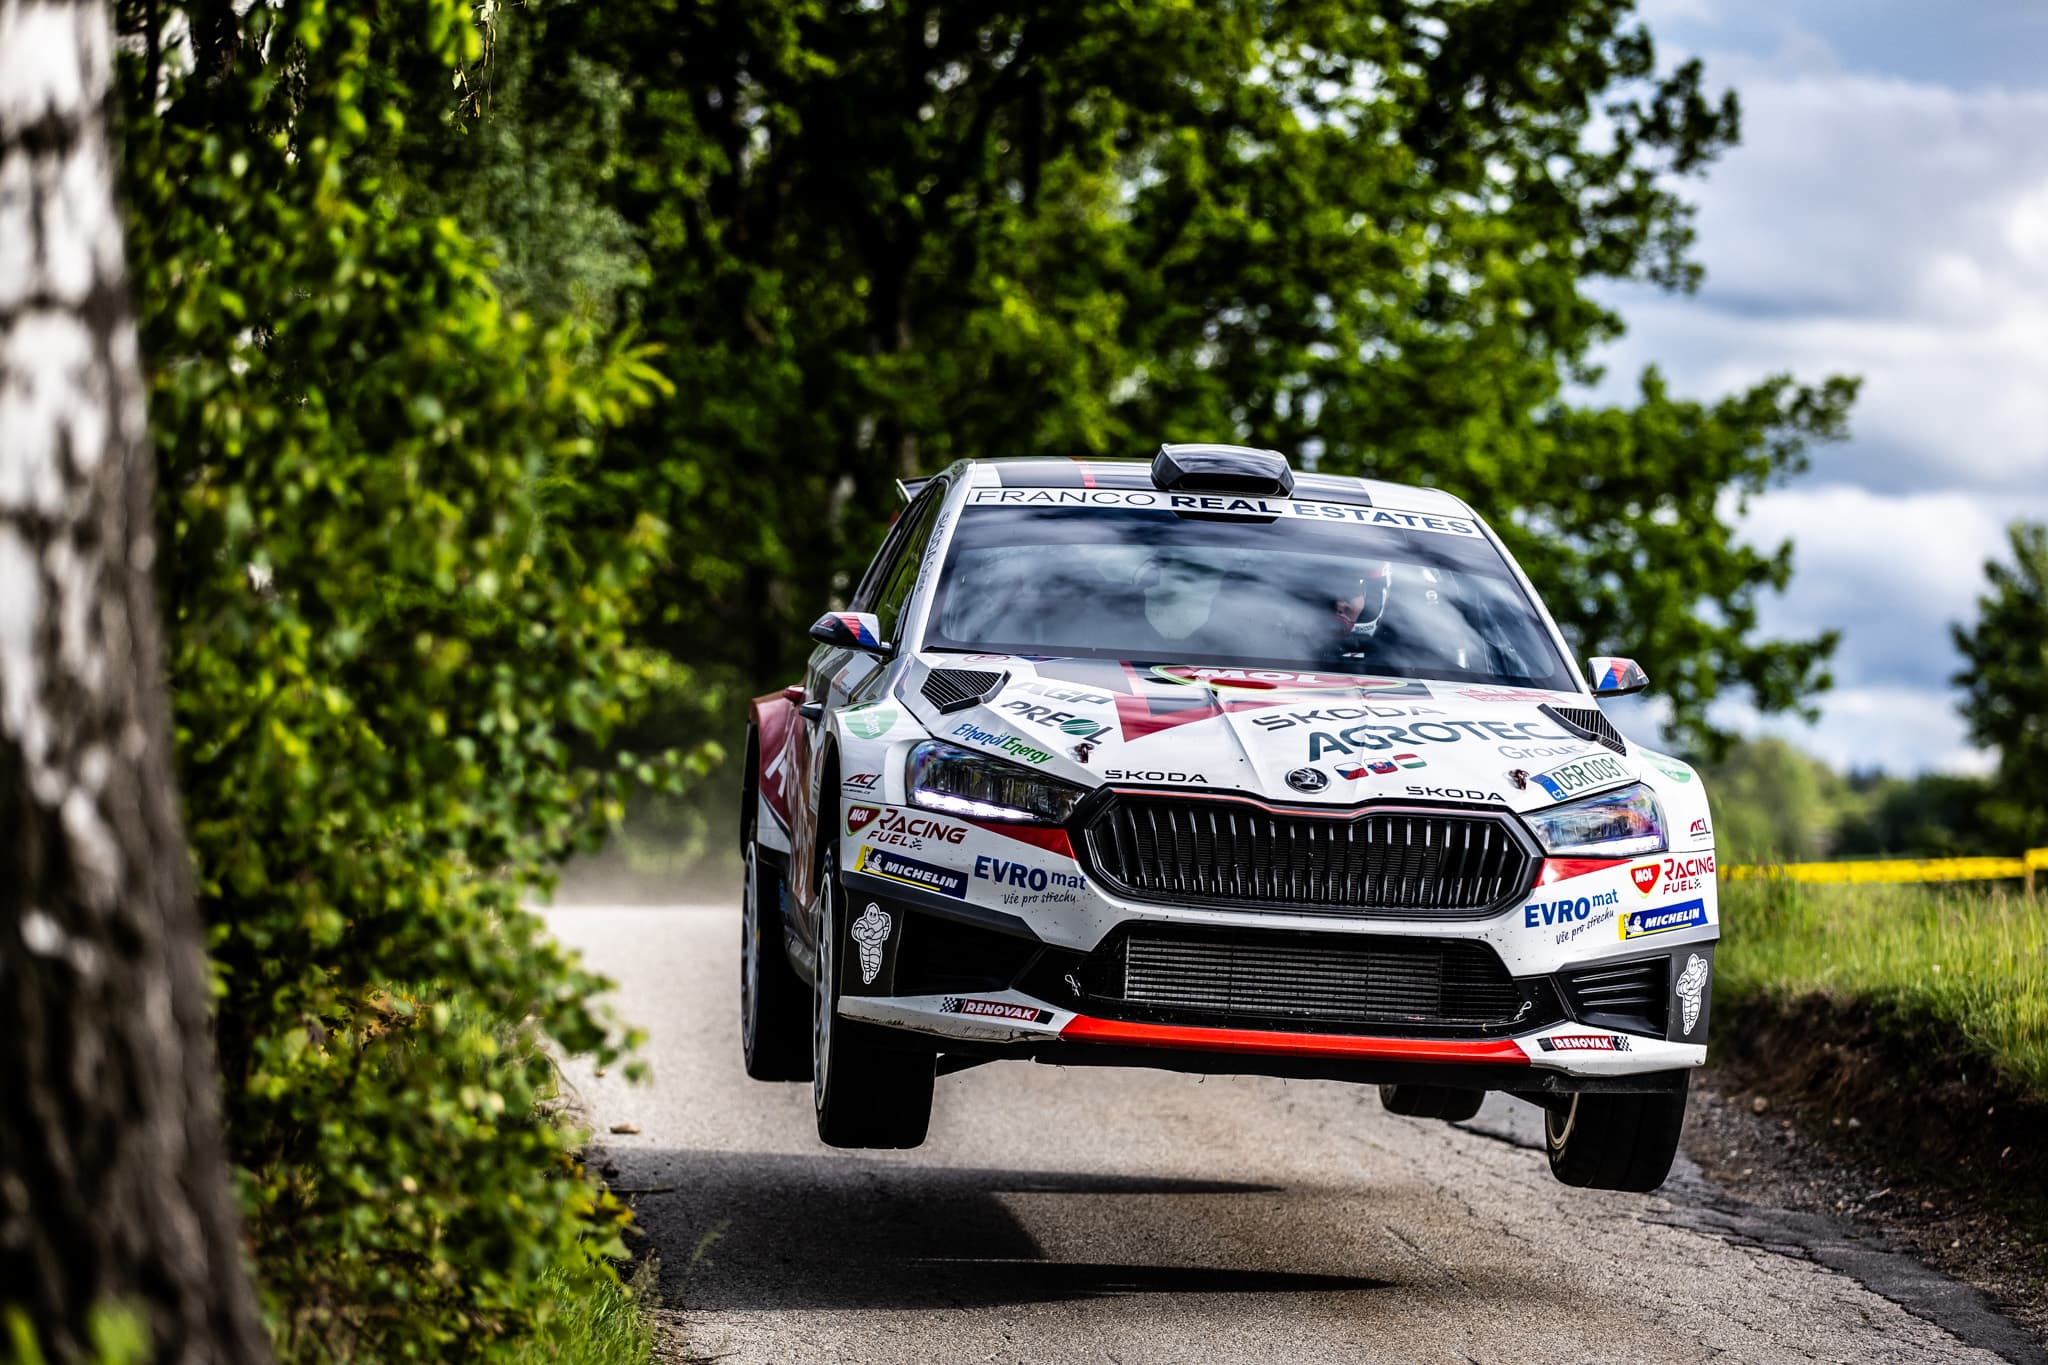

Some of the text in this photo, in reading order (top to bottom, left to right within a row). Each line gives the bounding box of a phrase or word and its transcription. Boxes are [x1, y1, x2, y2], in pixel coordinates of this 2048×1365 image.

[975, 490, 1474, 535] FRANCO REAL ESTATES
[1192, 668, 1324, 684] MOL
[1309, 719, 1576, 762] AGROTEC
[846, 773, 883, 790] ACL
[878, 808, 969, 845] RACING
[1690, 817, 1711, 834] ACL
[866, 830, 911, 847] FUEL
[884, 861, 959, 889] MICHELIN
[973, 855, 1087, 892] EVRO mat
[1634, 868, 1654, 884] MOL
[1663, 856, 1715, 881] RACING
[1662, 880, 1694, 895] FUEL
[1003, 893, 1019, 905] Vše
[1021, 894, 1039, 908] pro
[1524, 888, 1619, 929] EVRO mat
[1644, 908, 1700, 929] MICHELIN
[1555, 931, 1570, 945] Vše
[1571, 924, 1586, 942] pro
[964, 1001, 1035, 1020] RENOVAK
[1555, 1037, 1612, 1049] RENOVAK
